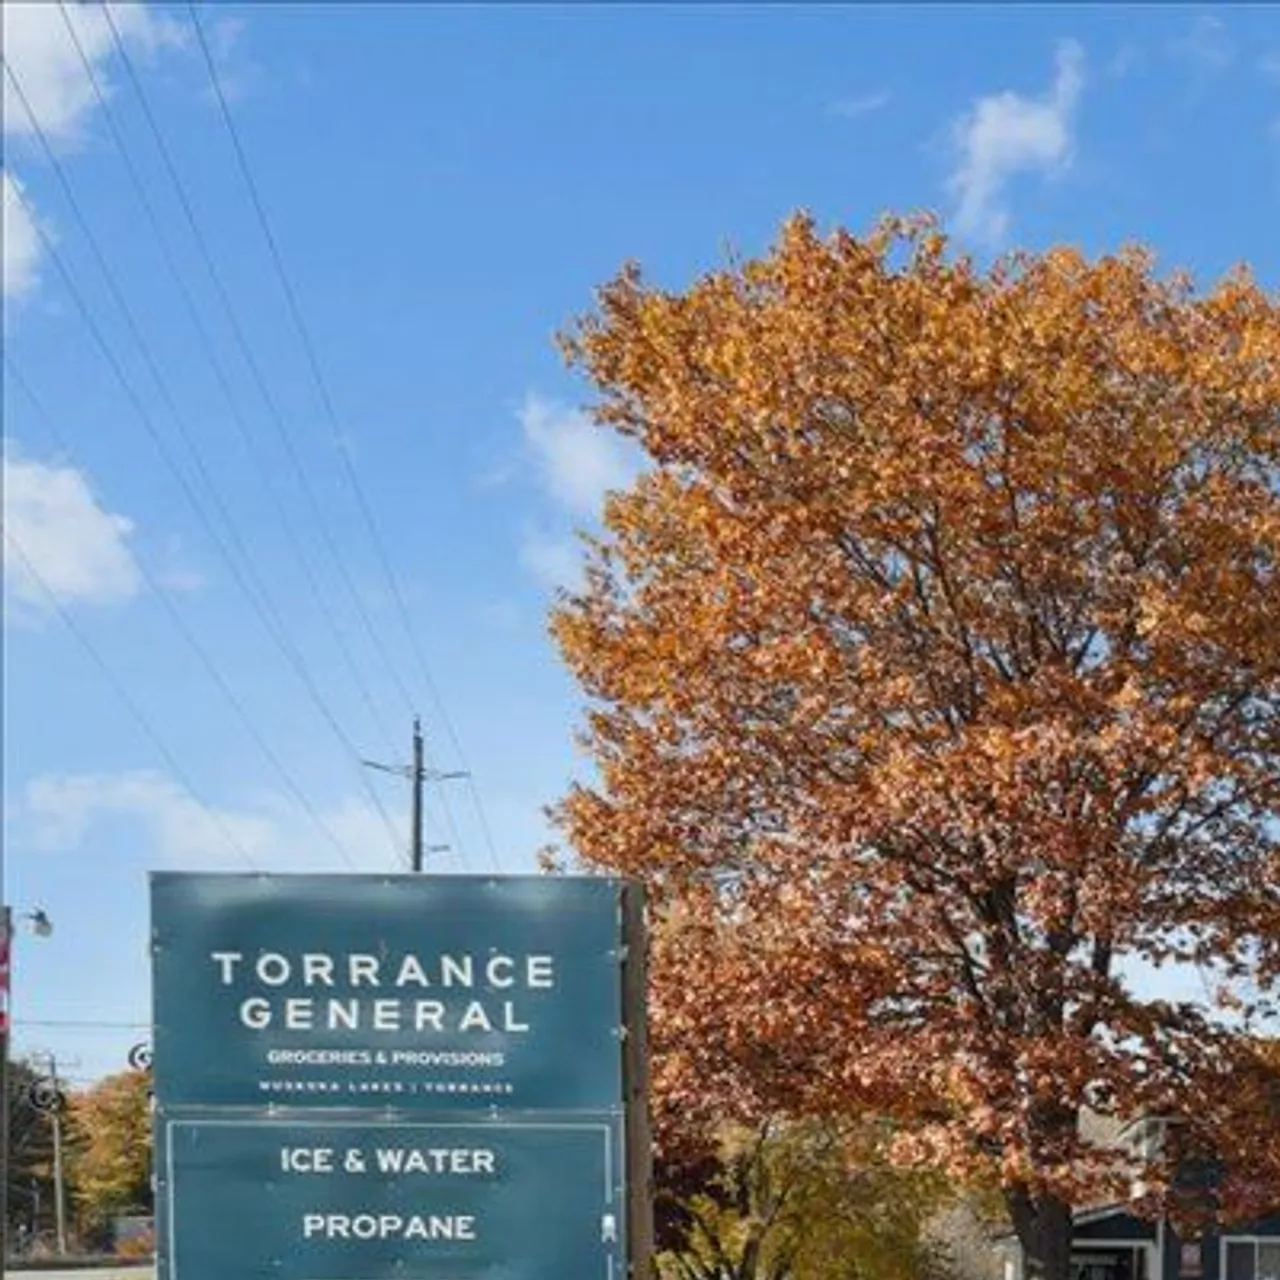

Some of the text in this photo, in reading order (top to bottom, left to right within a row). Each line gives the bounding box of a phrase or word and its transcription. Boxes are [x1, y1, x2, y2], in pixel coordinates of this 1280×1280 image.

[212, 953, 555, 988] TORRANCE
[240, 998, 530, 1031] GENERAL
[267, 1050, 504, 1066] GROCERIES & PROVISIONS
[281, 1149, 495, 1173] ICE & WATER
[303, 1215, 475, 1240] PROPANE
